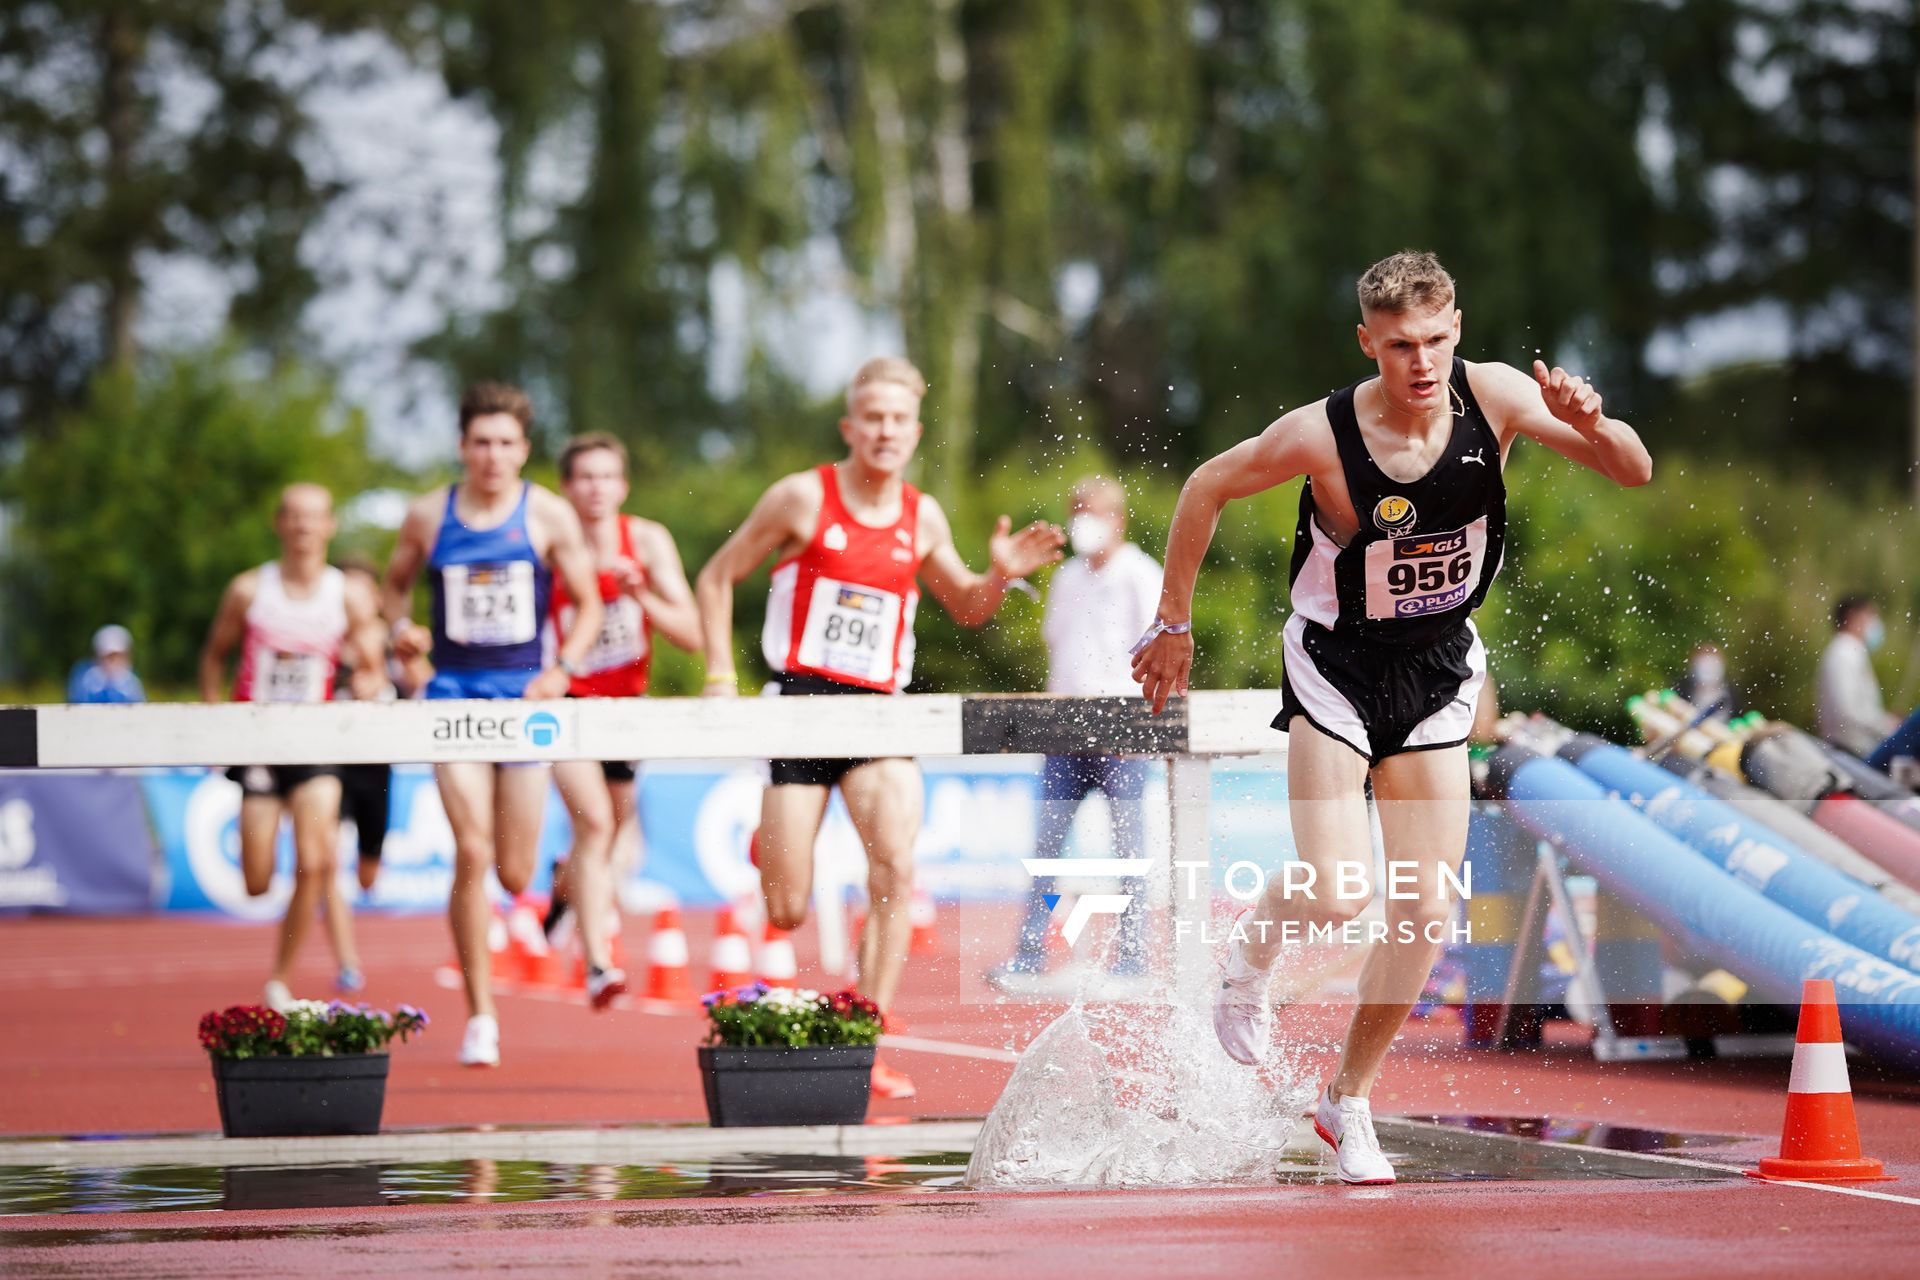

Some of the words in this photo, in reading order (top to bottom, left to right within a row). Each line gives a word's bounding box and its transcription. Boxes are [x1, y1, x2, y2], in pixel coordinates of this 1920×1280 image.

[1433, 535, 1462, 553] GLS
[1387, 551, 1472, 595] 956
[1426, 588, 1465, 606] PLAN
[433, 713, 517, 740] artec
